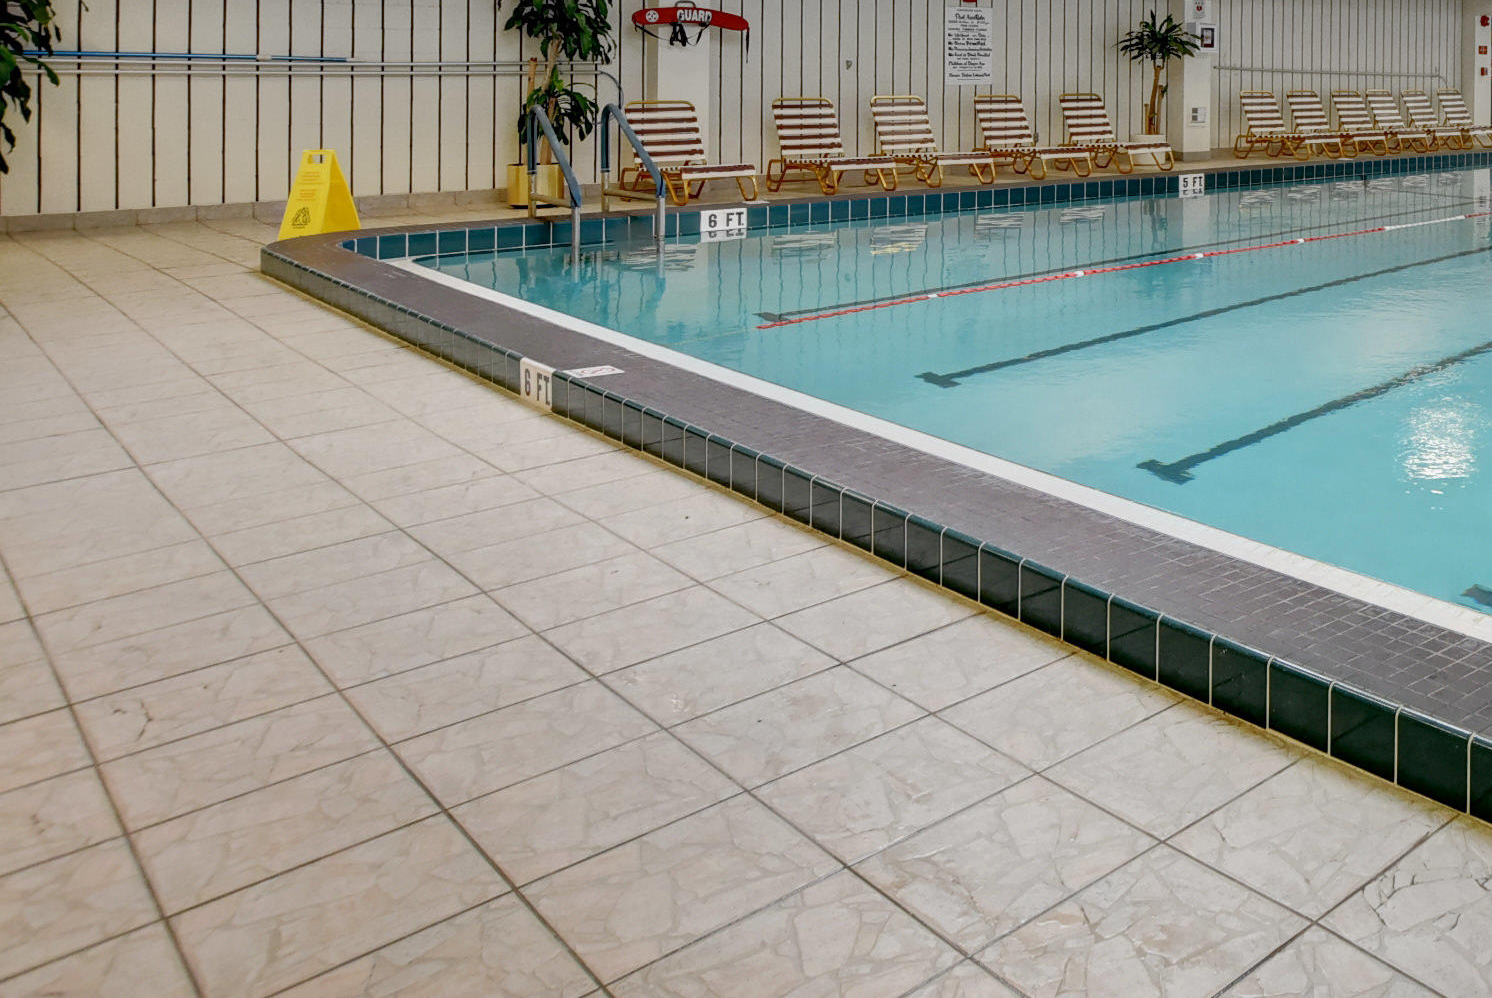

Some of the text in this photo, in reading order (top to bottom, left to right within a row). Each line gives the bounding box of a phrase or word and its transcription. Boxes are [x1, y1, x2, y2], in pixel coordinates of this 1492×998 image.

[676, 9, 712, 22] GUARD
[1183, 177, 1188, 188] 5
[708, 211, 744, 228] 6 FT.
[524, 368, 531, 396] 6
